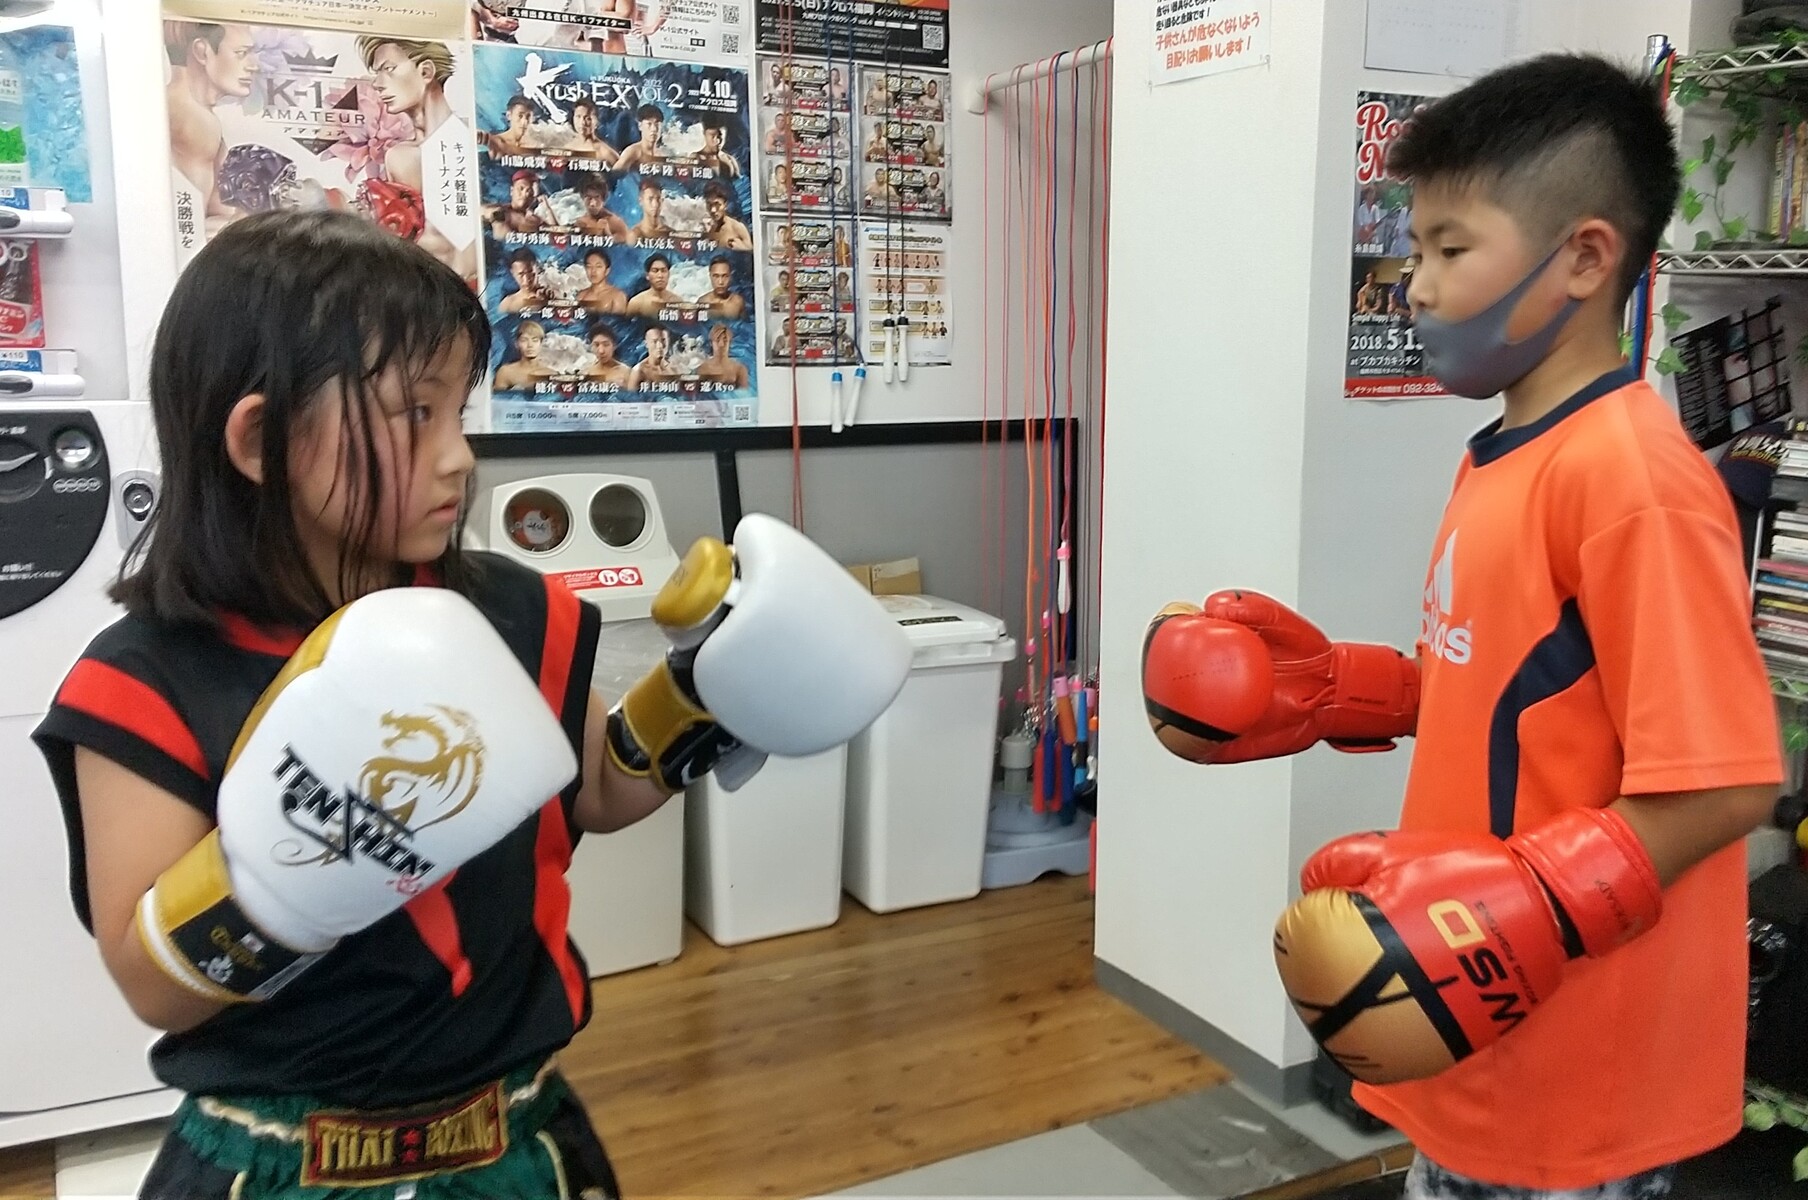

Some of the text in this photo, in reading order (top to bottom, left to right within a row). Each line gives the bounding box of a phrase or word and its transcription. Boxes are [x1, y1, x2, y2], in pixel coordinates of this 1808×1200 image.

[1155, 12, 1260, 51] 子供さんが危なくないよう
[1166, 35, 1251, 70] 目配りお願いします！
[266, 78, 325, 111] K-1
[516, 52, 635, 123] Krush EX
[599, 75, 631, 84] FUKUOKA
[700, 79, 730, 99] 4.10
[261, 108, 366, 125] AMATEUR
[282, 127, 345, 136] アマチュア
[439, 141, 452, 216] トーナメント
[453, 142, 468, 217] キッズ軽量級
[177, 190, 194, 249] 決勝戦を
[1427, 899, 1528, 1036] WSD
[317, 1120, 397, 1171] THAI
